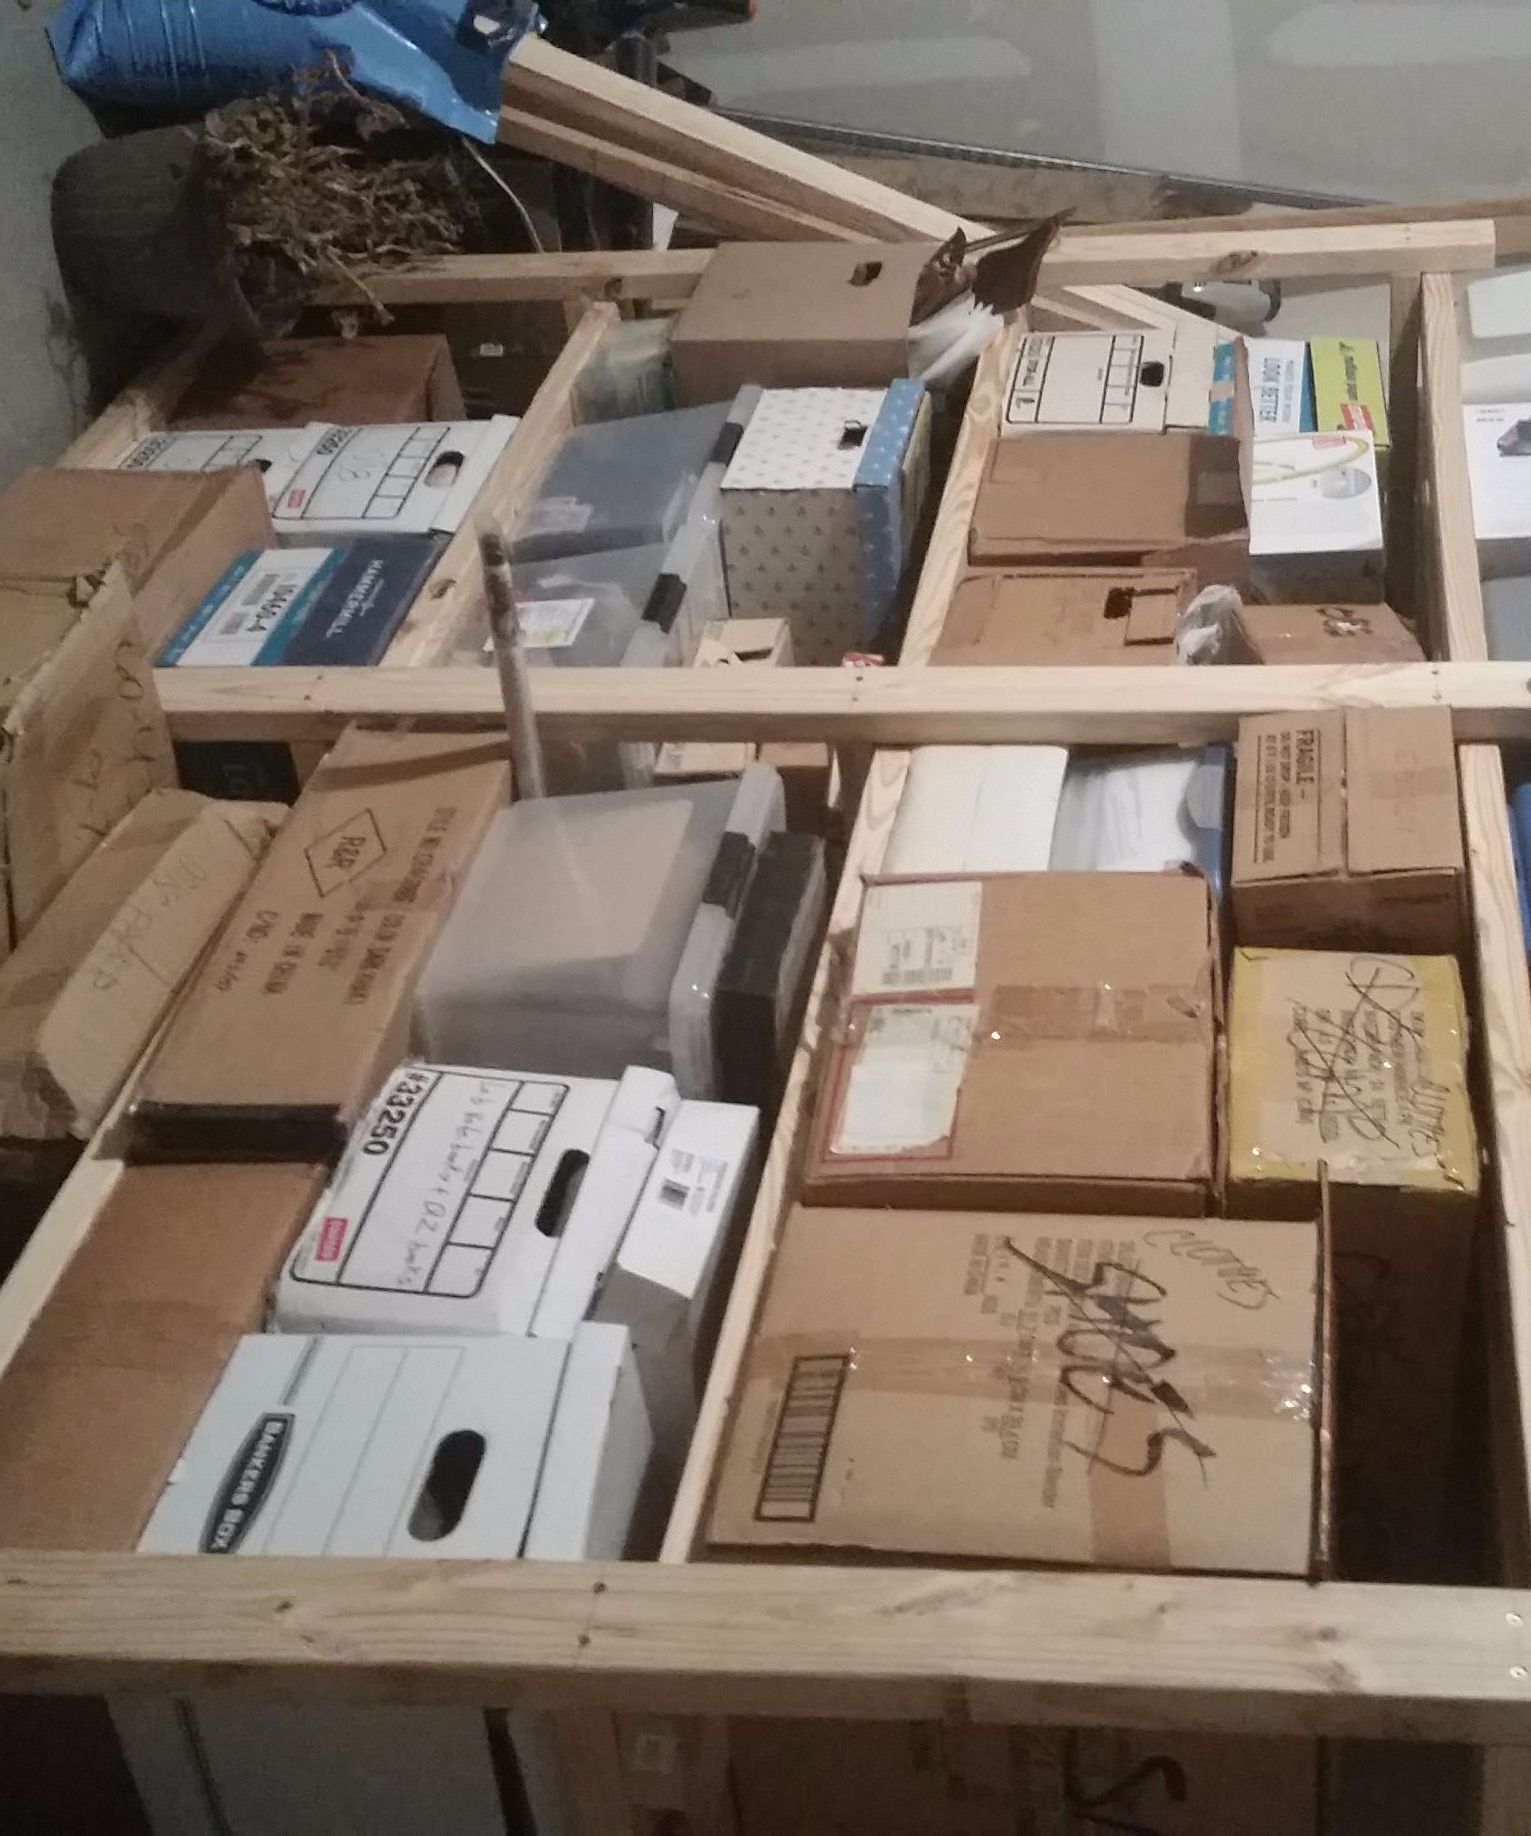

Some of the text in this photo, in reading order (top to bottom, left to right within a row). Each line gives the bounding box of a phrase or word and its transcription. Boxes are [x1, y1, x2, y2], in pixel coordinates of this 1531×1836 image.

[362, 1071, 430, 1157] #33250
[208, 1420, 285, 1550] BANKERS BOX
